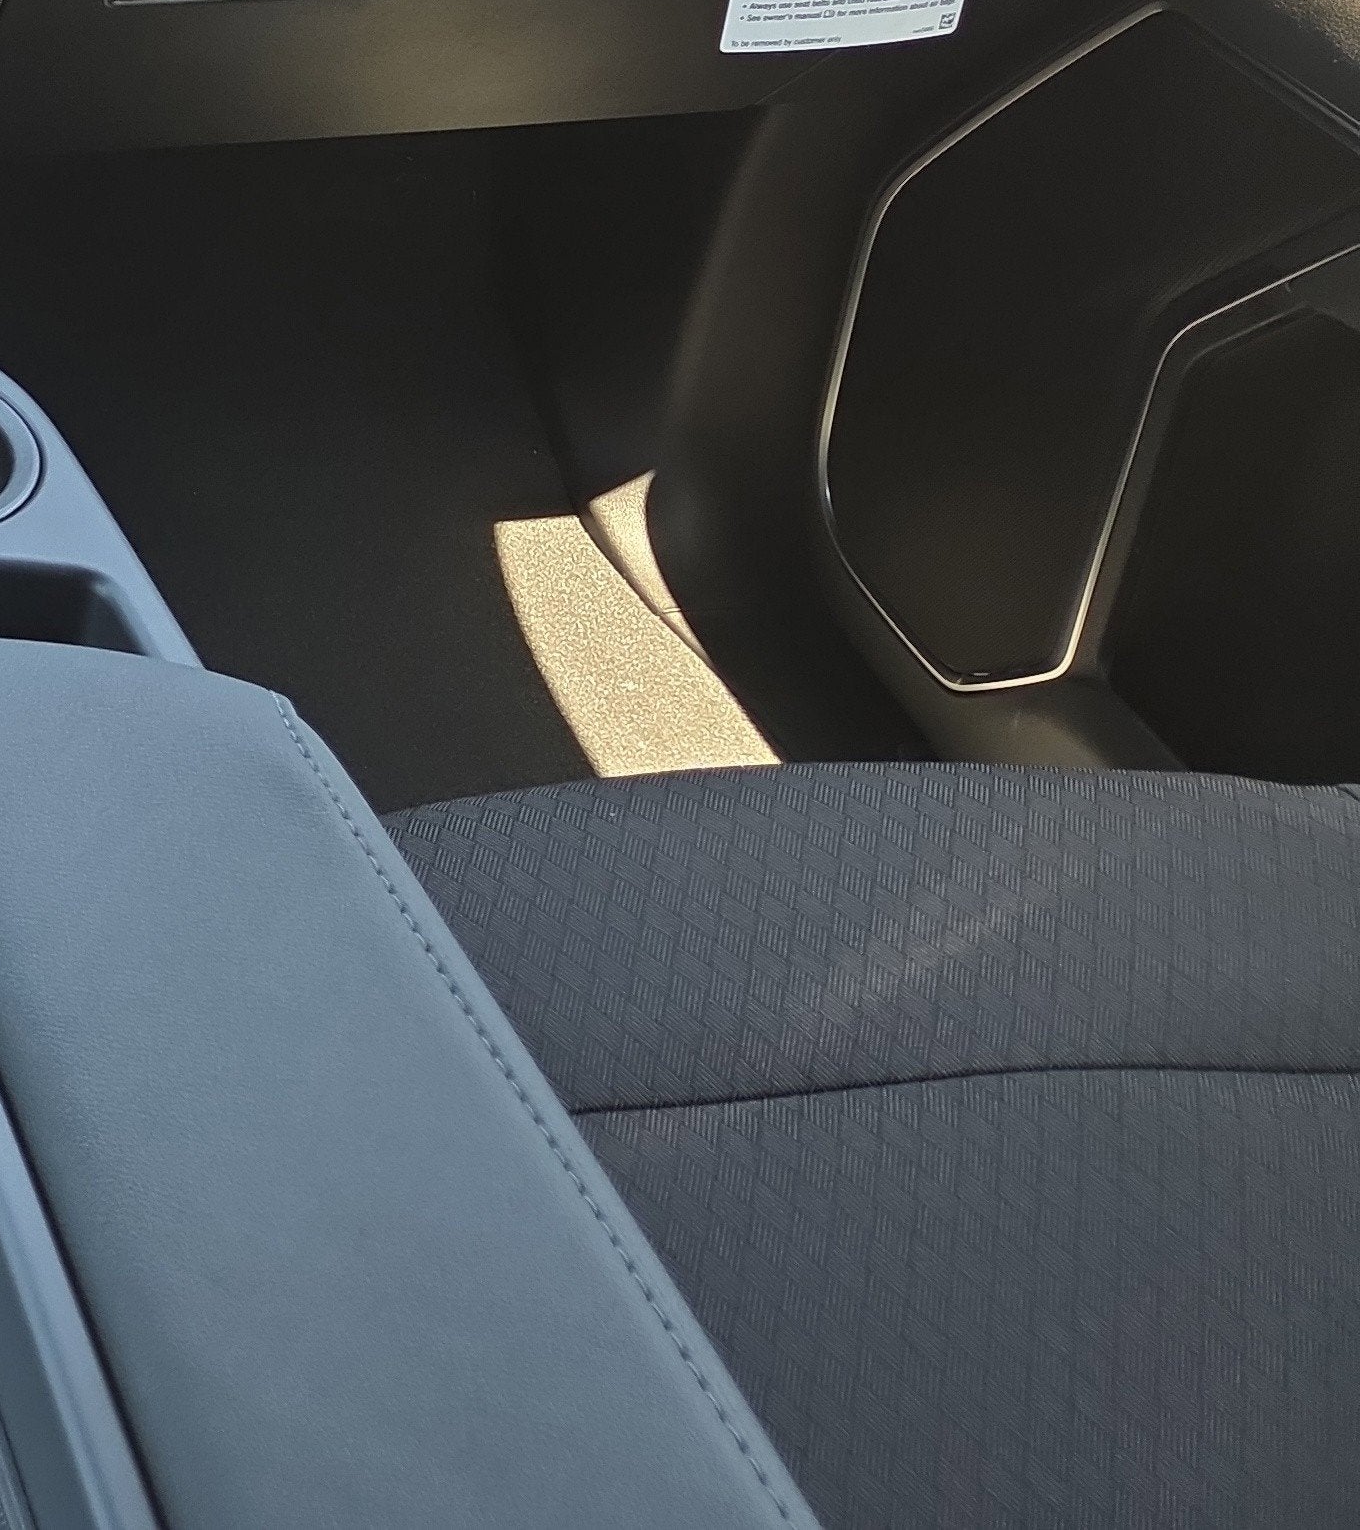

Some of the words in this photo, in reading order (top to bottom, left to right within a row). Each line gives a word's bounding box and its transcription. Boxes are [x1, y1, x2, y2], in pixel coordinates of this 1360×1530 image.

[746, 12, 761, 22] See
[763, 11, 793, 21] owner's
[794, 9, 822, 20] manual
[836, 8, 847, 16] for
[848, 7, 867, 16] more
[869, 3, 908, 14] information
[909, 1, 928, 10] about
[750, 0, 778, 10] Always
[779, 0, 792, 8] use
[740, 39, 750, 47] be
[751, 38, 782, 46] removed
[784, 36, 792, 46] by
[793, 35, 825, 45] customer
[827, 34, 842, 44] only
